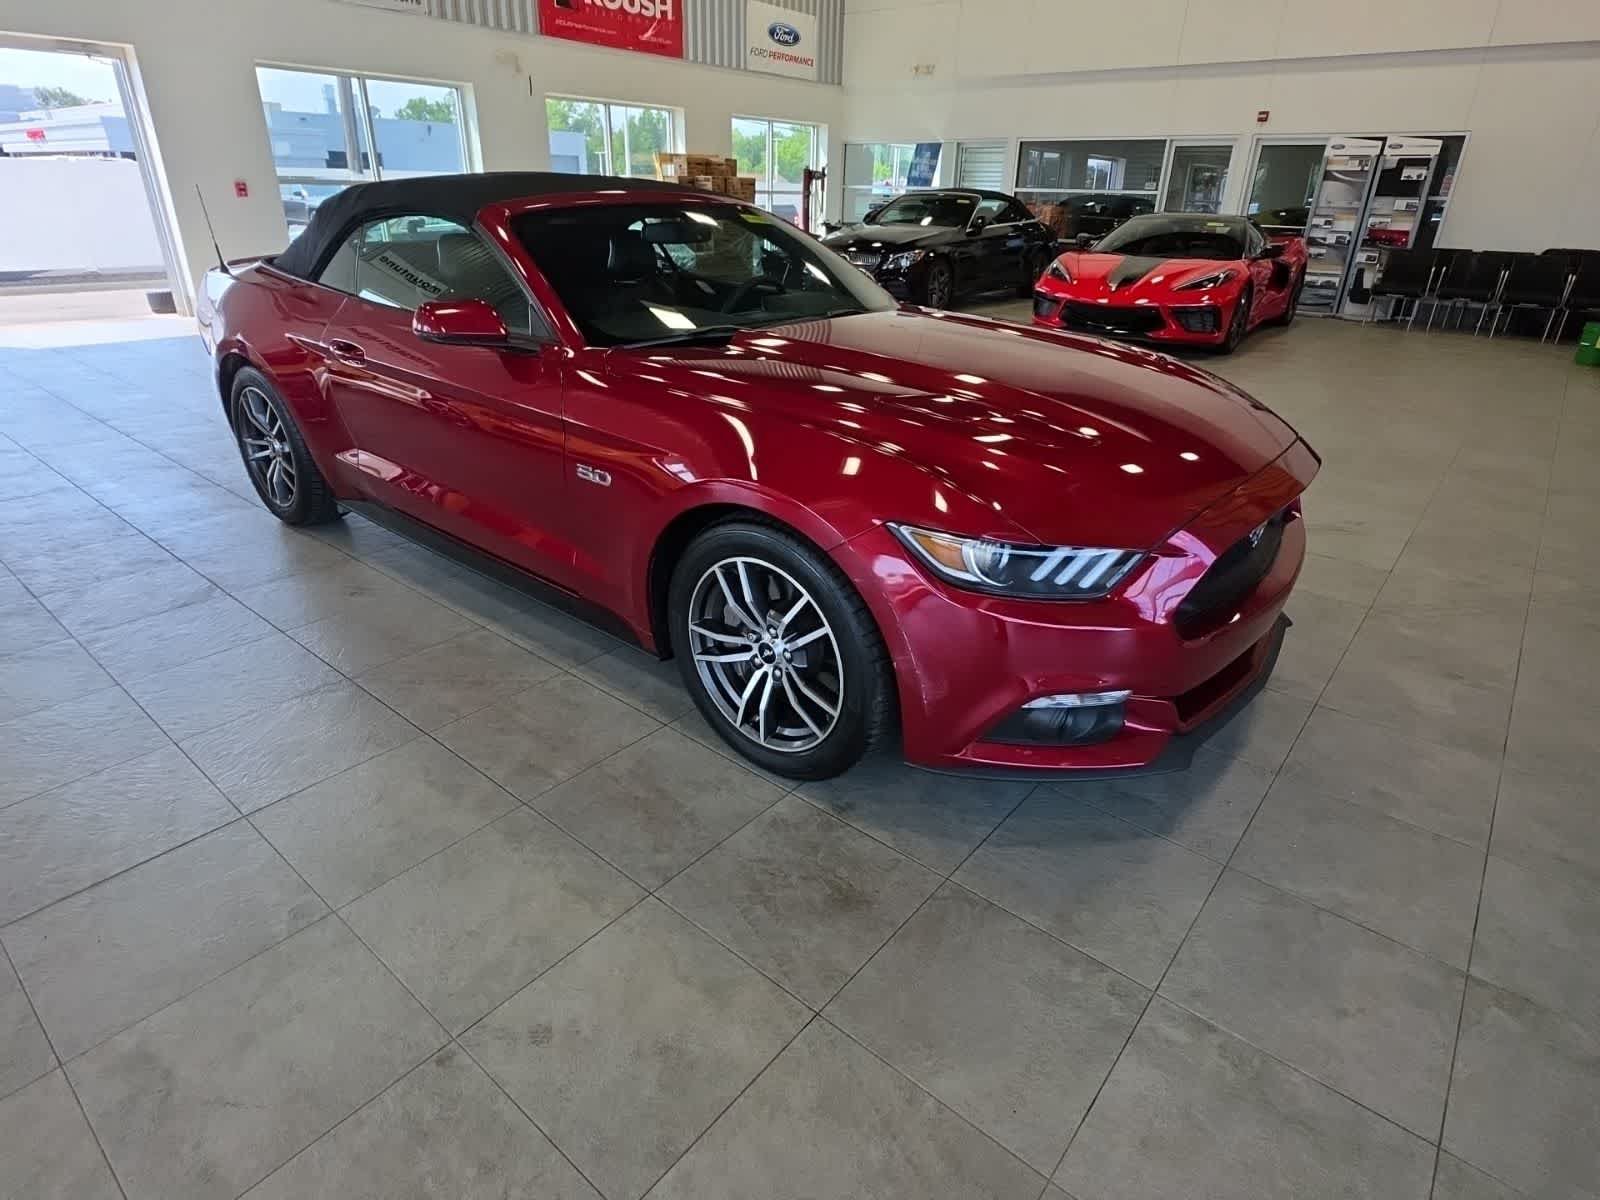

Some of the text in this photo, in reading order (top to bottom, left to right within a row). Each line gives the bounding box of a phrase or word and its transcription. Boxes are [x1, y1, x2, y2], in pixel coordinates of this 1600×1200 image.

[584, 0, 672, 20] USH
[774, 25, 795, 43] Ford
[750, 47, 814, 67] FORD PERFORMANCE
